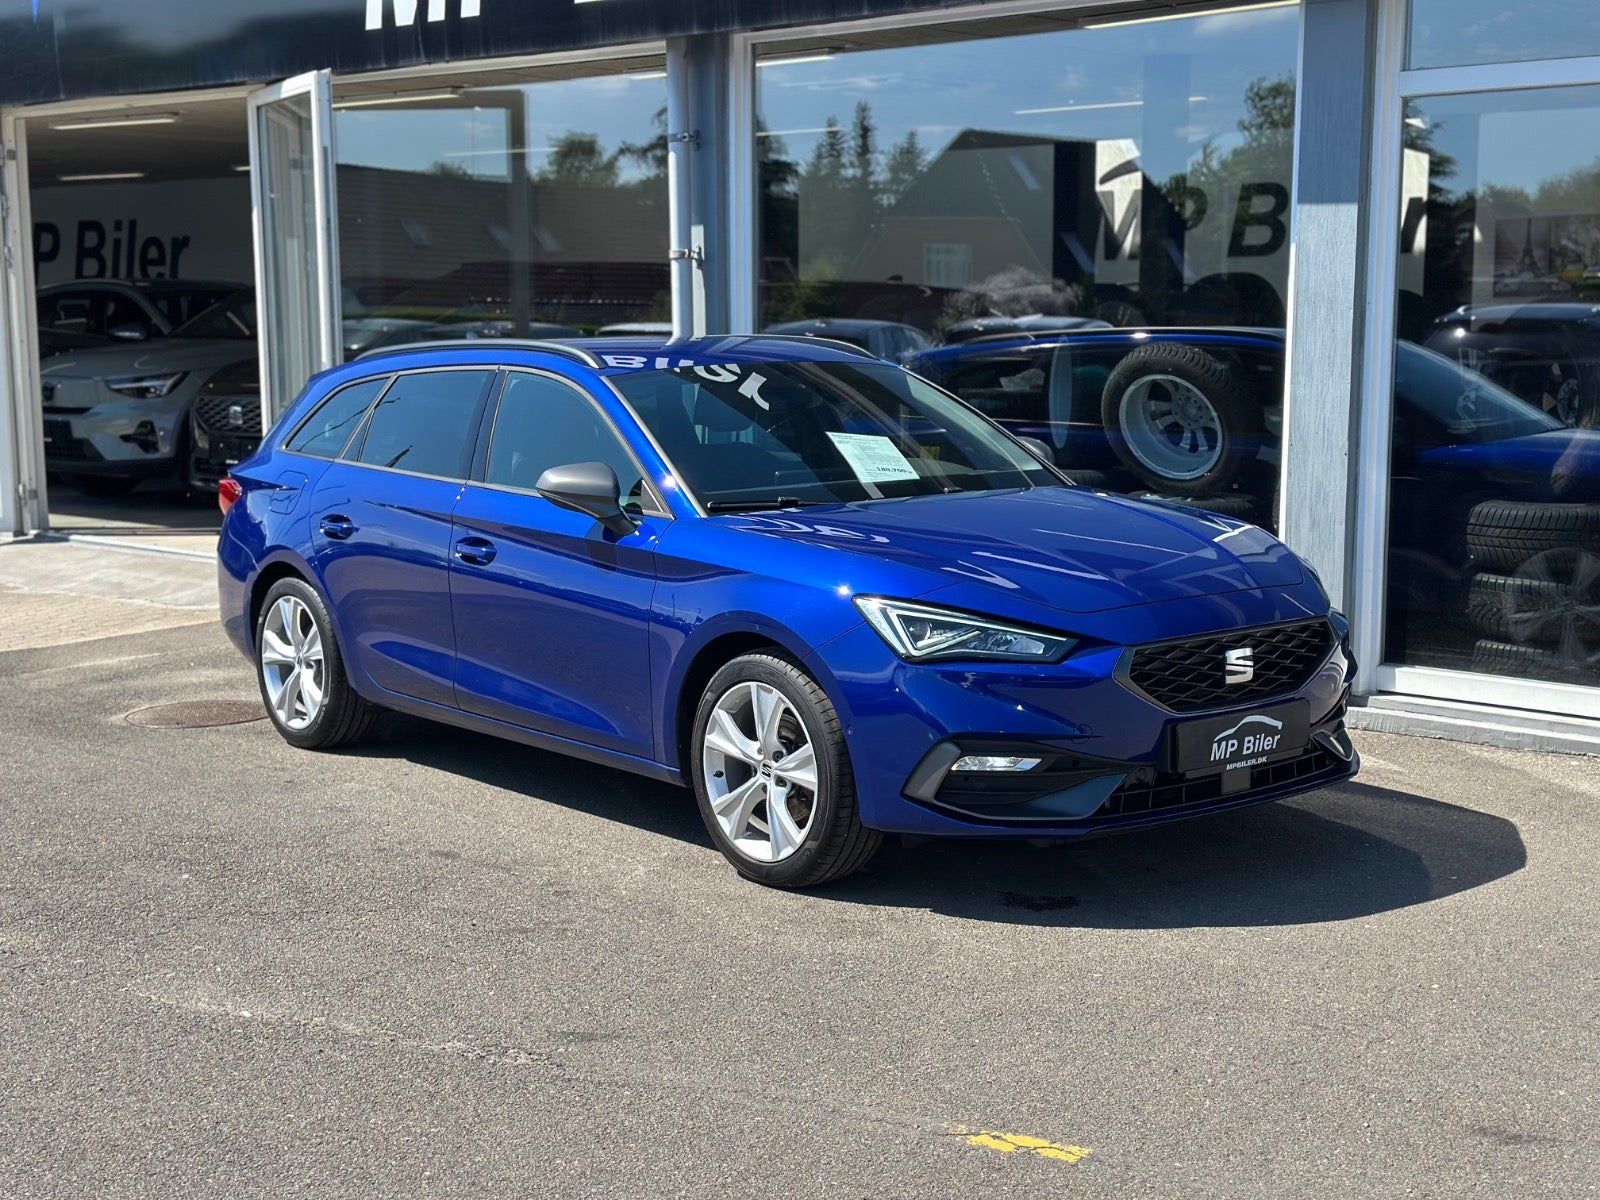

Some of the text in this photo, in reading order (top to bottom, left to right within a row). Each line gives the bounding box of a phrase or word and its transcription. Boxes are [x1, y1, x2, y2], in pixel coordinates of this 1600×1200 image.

[33, 218, 191, 286] P Biler
[1210, 733, 1281, 761] MP Biler
[1226, 756, 1267, 770] MPBILER.DK
